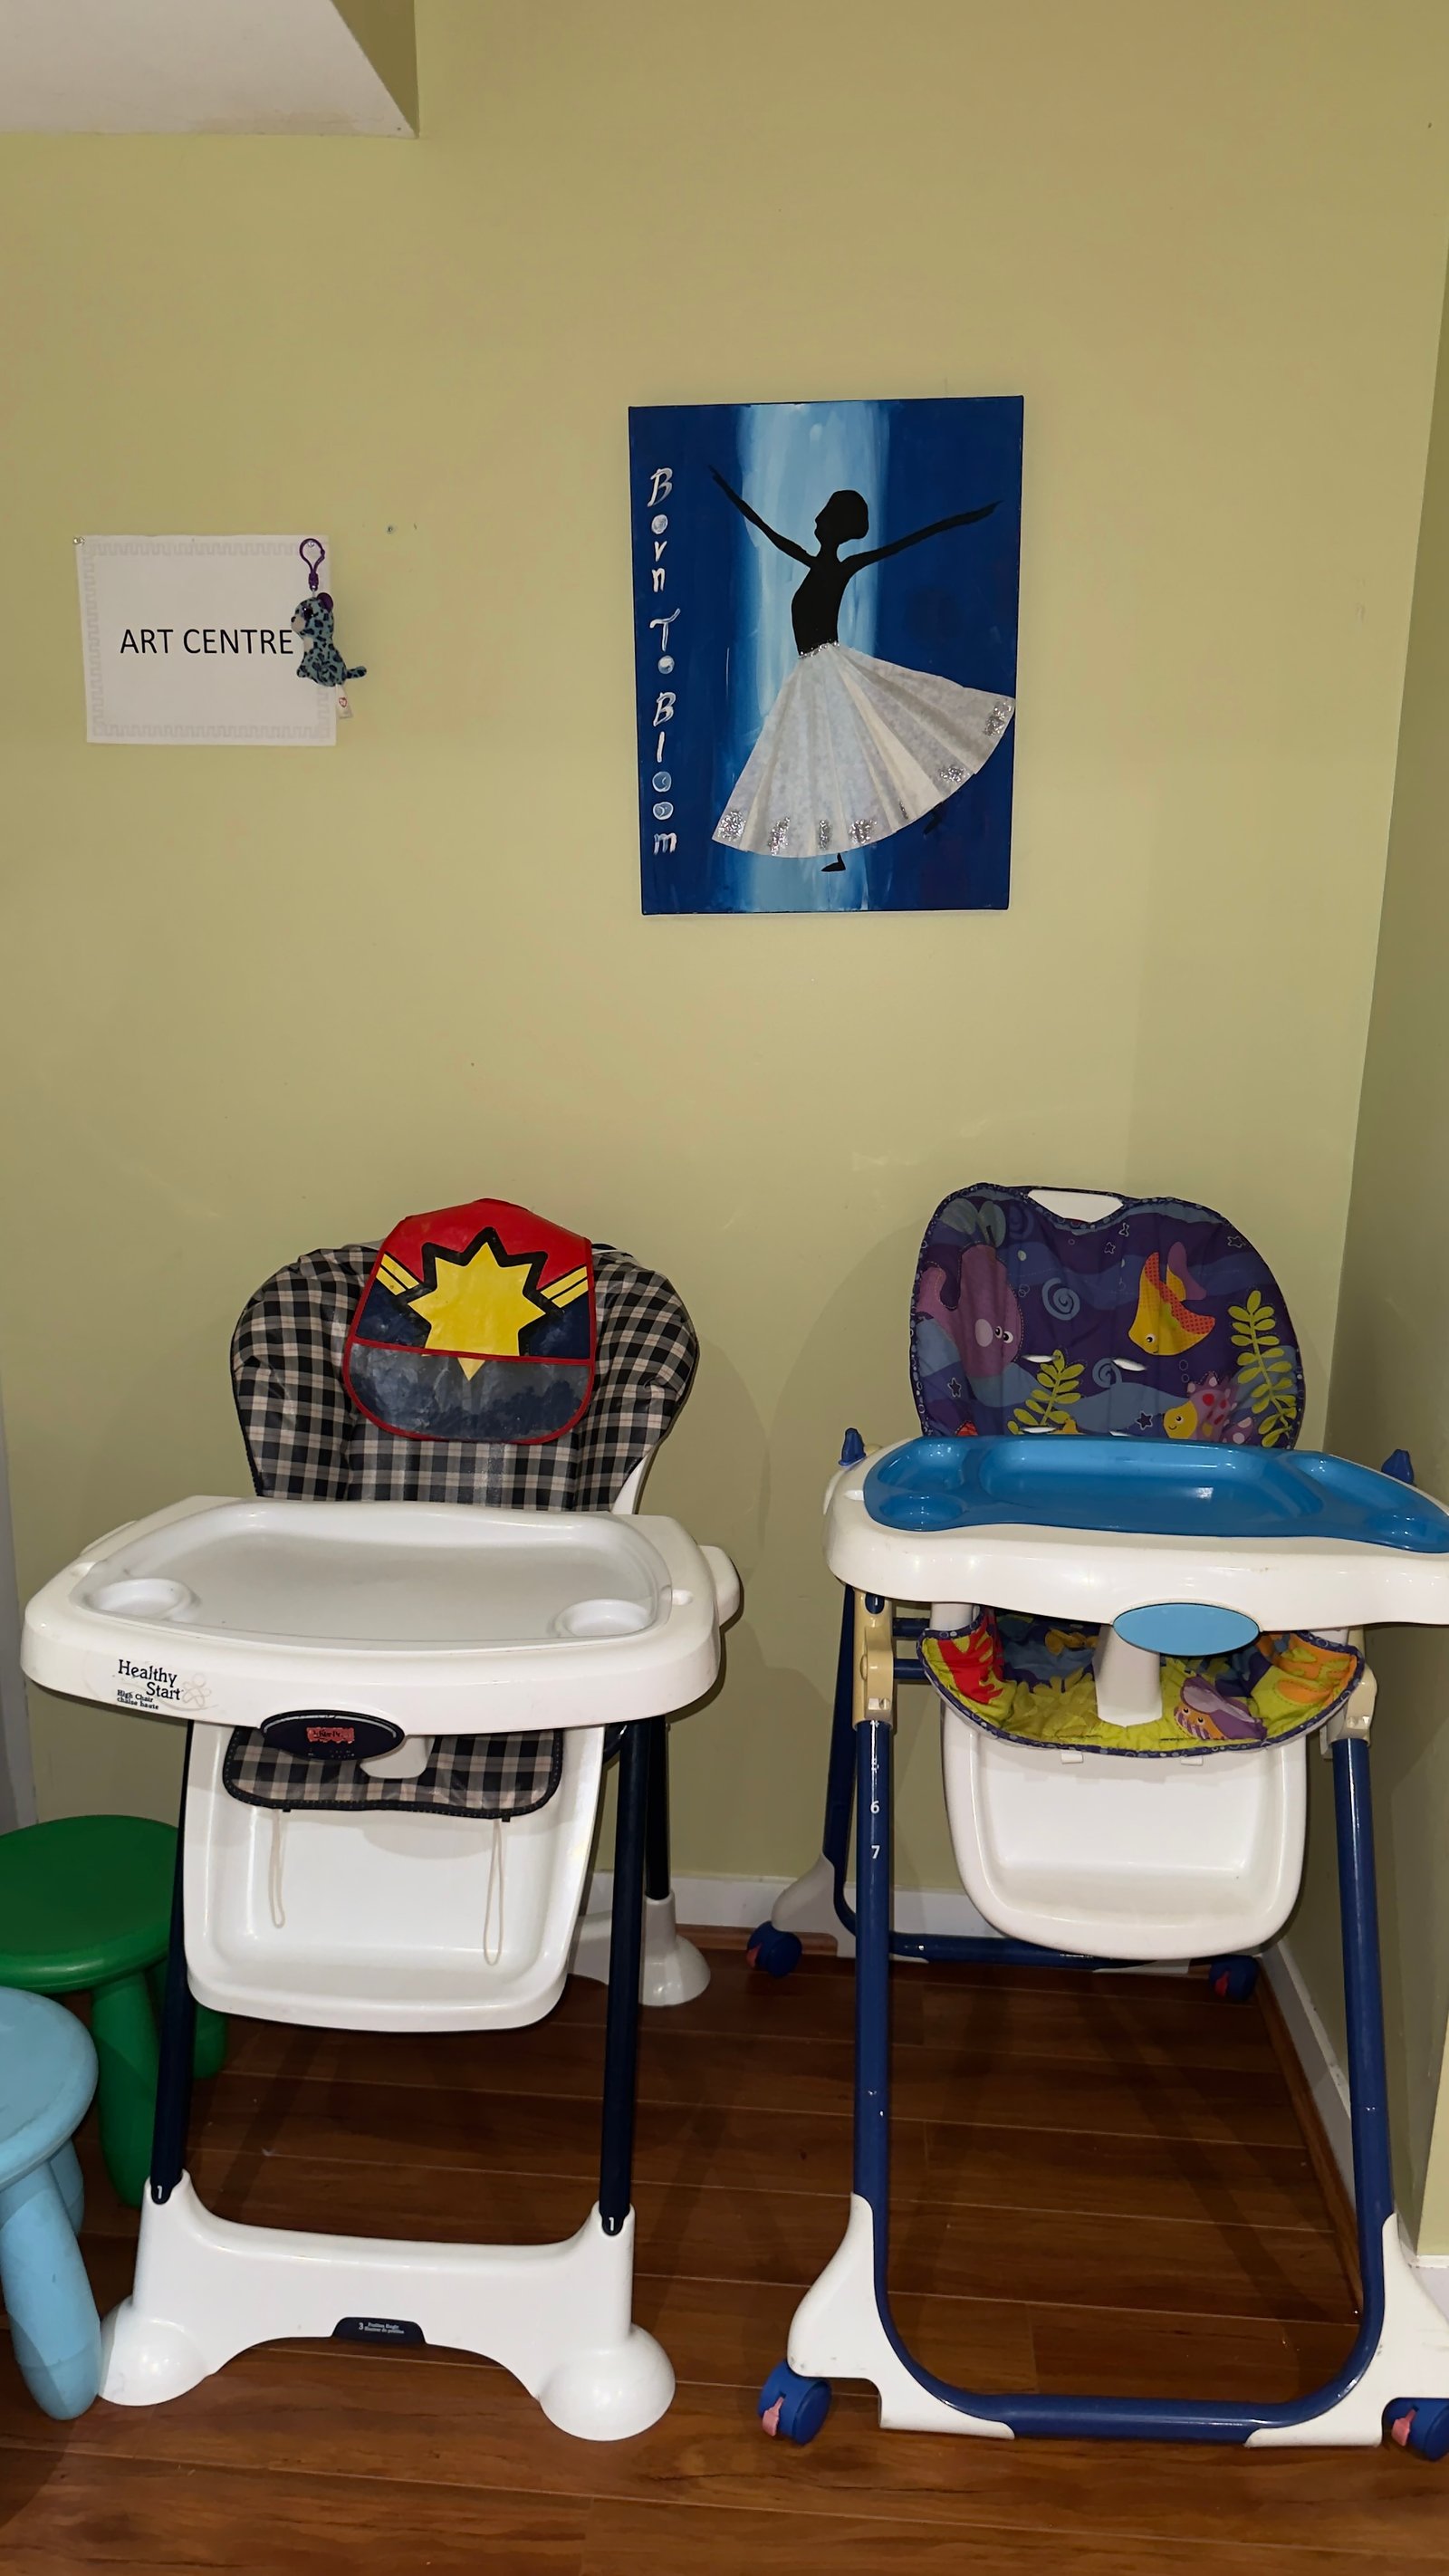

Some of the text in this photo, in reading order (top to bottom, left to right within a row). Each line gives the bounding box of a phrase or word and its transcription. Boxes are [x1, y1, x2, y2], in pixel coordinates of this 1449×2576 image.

[120, 629, 293, 654] ART CENTRE
[646, 466, 681, 855] Born To Bloom
[118, 1658, 178, 1687] Healthy
[117, 1689, 154, 1703] High Chair
[146, 1681, 180, 1700] Start
[870, 1800, 880, 1814] 6
[871, 1845, 880, 1860] 7
[157, 2185, 163, 2199] 1
[609, 2216, 615, 2232] 1
[358, 2321, 364, 2331] 3
